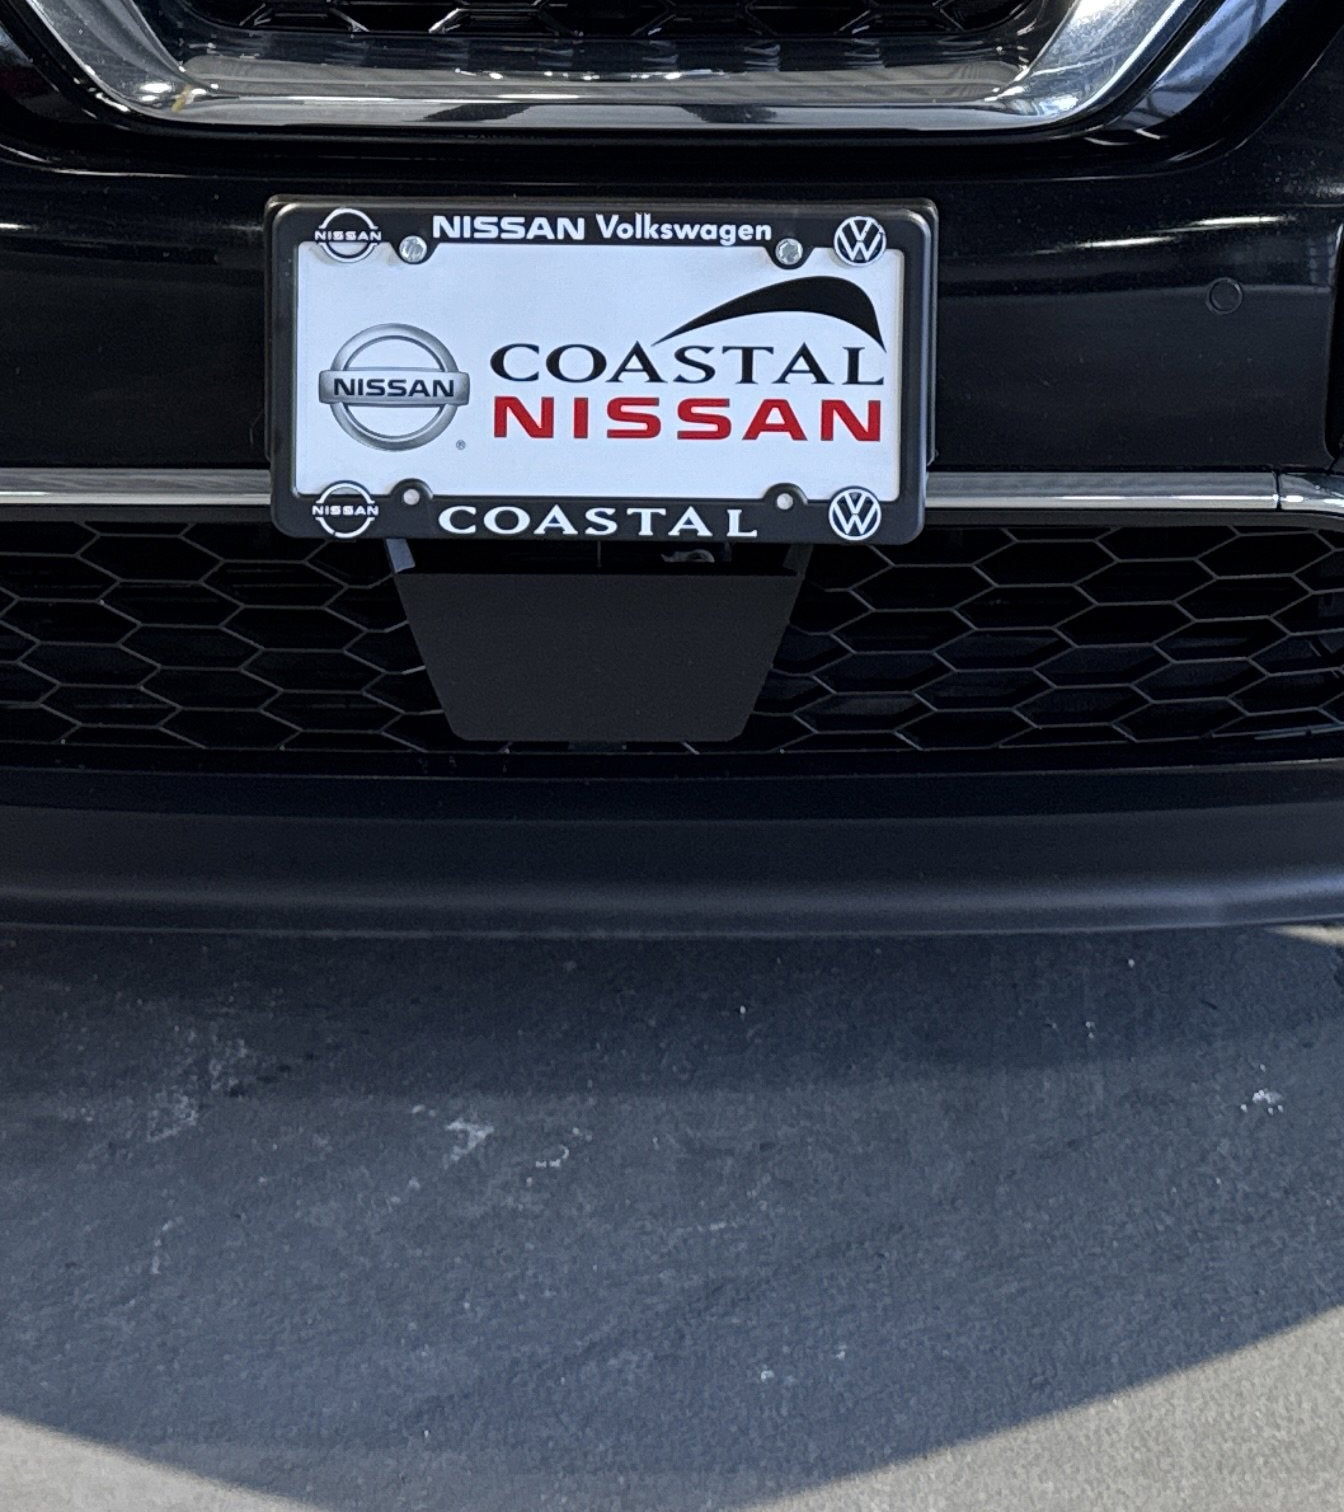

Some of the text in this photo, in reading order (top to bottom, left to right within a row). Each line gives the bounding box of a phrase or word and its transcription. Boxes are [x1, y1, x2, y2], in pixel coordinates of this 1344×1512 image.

[314, 230, 382, 241] NISSAN
[432, 213, 772, 245] NISSAN Volkswagen
[489, 341, 885, 386] COASTAL
[333, 377, 455, 399] NISSAN
[492, 395, 881, 442] NISSAN
[312, 505, 380, 516] NISSAN
[438, 504, 758, 538] COASTAL
